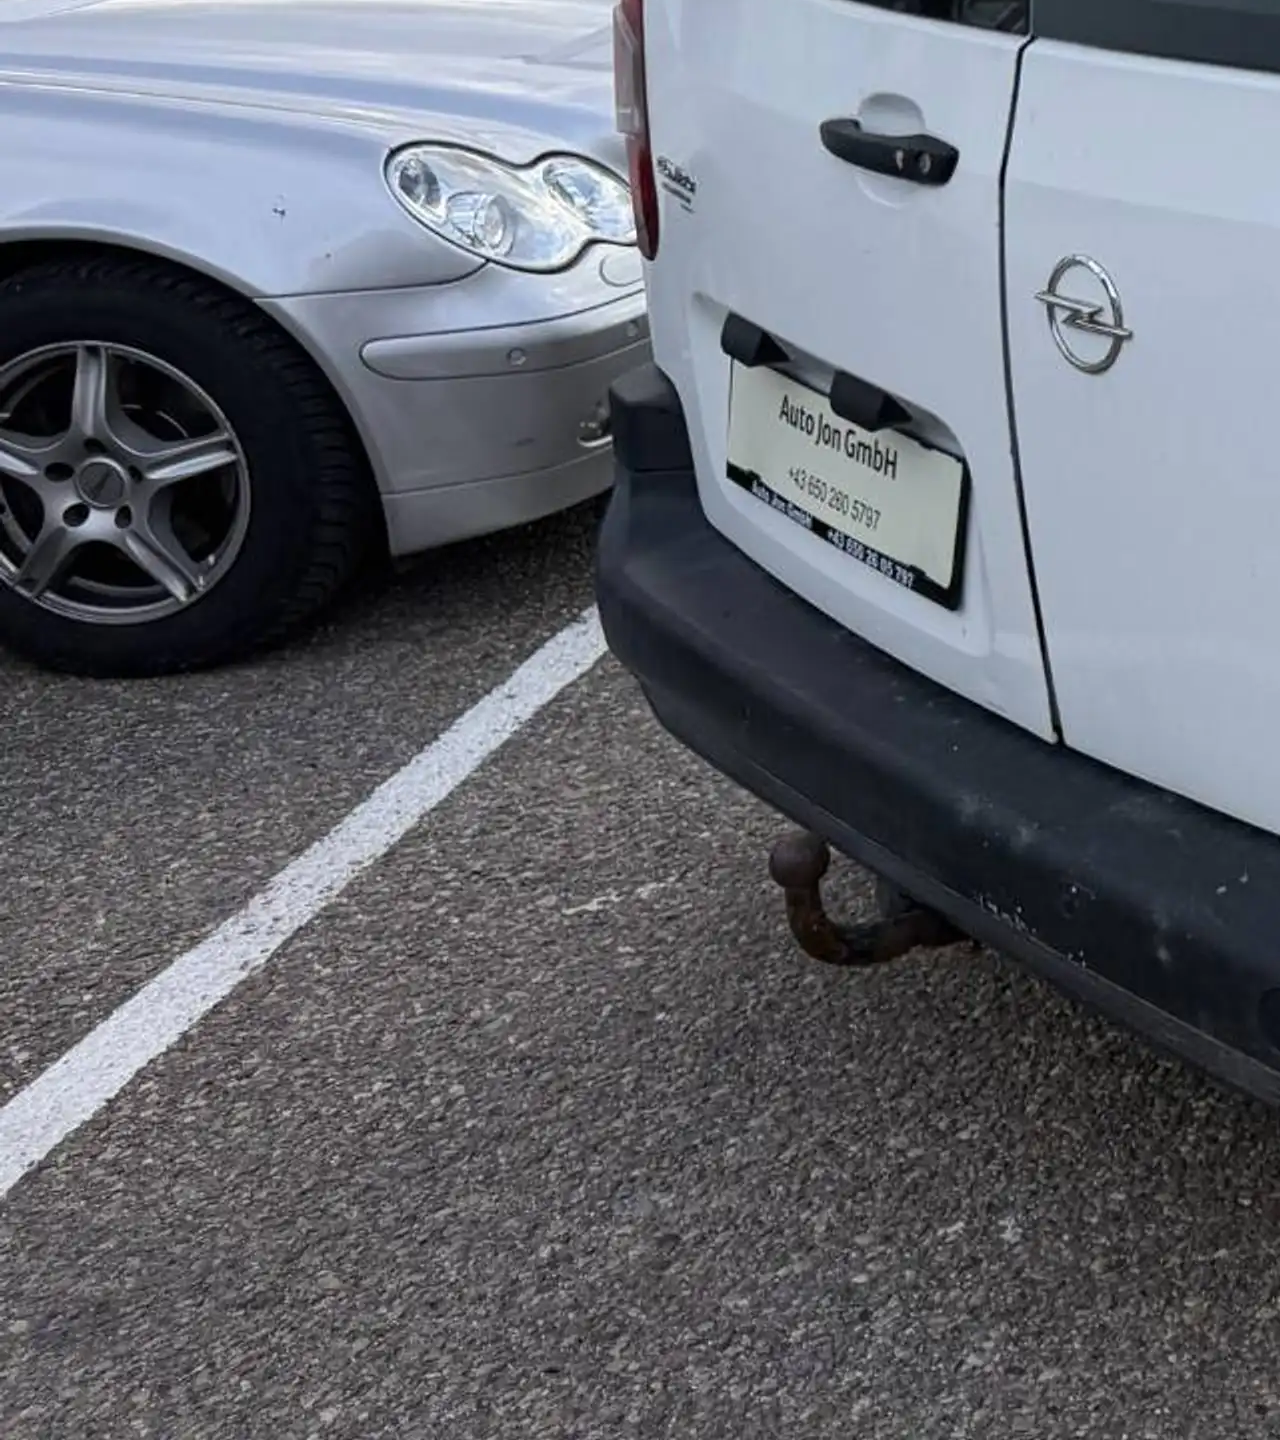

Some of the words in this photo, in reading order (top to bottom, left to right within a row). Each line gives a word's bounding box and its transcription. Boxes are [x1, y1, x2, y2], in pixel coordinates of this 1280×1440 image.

[779, 393, 815, 435] Auto
[814, 413, 842, 452] Jon
[844, 428, 898, 481] GmbH
[788, 467, 807, 491] +43
[850, 498, 882, 531] 5797
